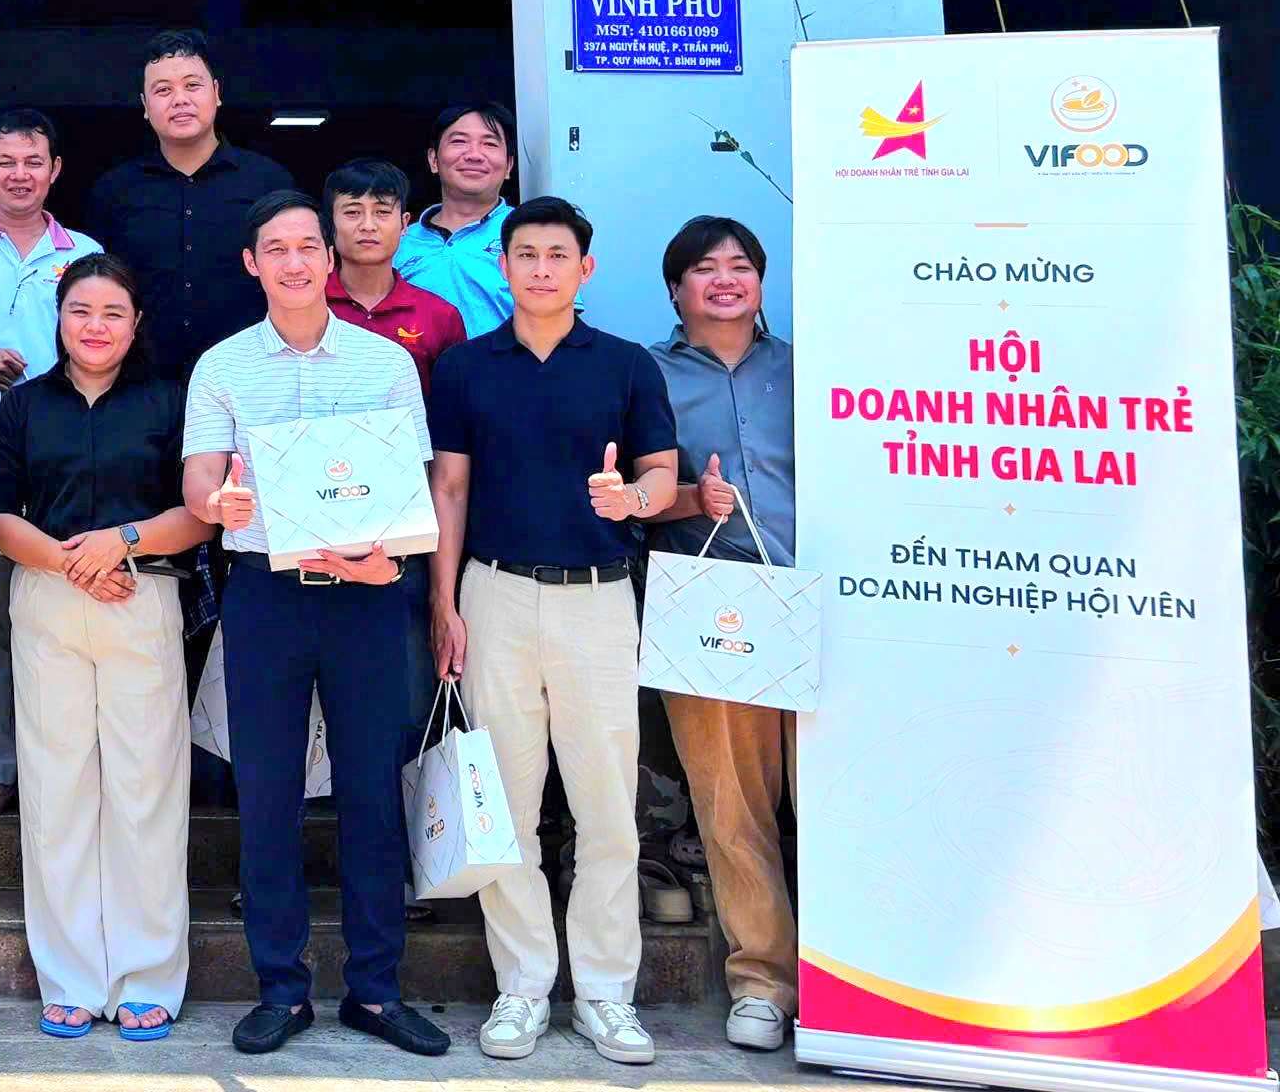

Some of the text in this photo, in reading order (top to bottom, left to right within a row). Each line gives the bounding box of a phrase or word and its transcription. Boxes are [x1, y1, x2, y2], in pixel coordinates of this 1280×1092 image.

[595, 24, 719, 38] MST: 4101661099
[583, 41, 607, 52] 397A
[609, 39, 646, 52] NGUYỄN
[672, 43, 682, 52] P.
[595, 55, 610, 65] TP.
[612, 56, 630, 66] QUY
[663, 58, 673, 66] T.
[675, 55, 697, 66] BÌNH
[699, 57, 721, 68] ĐỊNH
[1024, 143, 1148, 167] VIFOOD
[850, 169, 878, 177] DOANH
[940, 168, 955, 177] GIA
[956, 168, 970, 177] LAI
[913, 257, 1095, 283] CHÀO MỪNG
[969, 330, 1040, 382] HỘI
[831, 385, 1193, 432] DOANH NHÂN TRẺ
[882, 430, 1136, 486] TỈNH GIA LAI
[316, 484, 371, 500] VIFOOD
[890, 535, 1136, 578] ĐẾN THAM QUAN
[839, 576, 1195, 619] DOANH NGHIỆP HỘI VIÊN
[699, 635, 754, 653] VIFOOD
